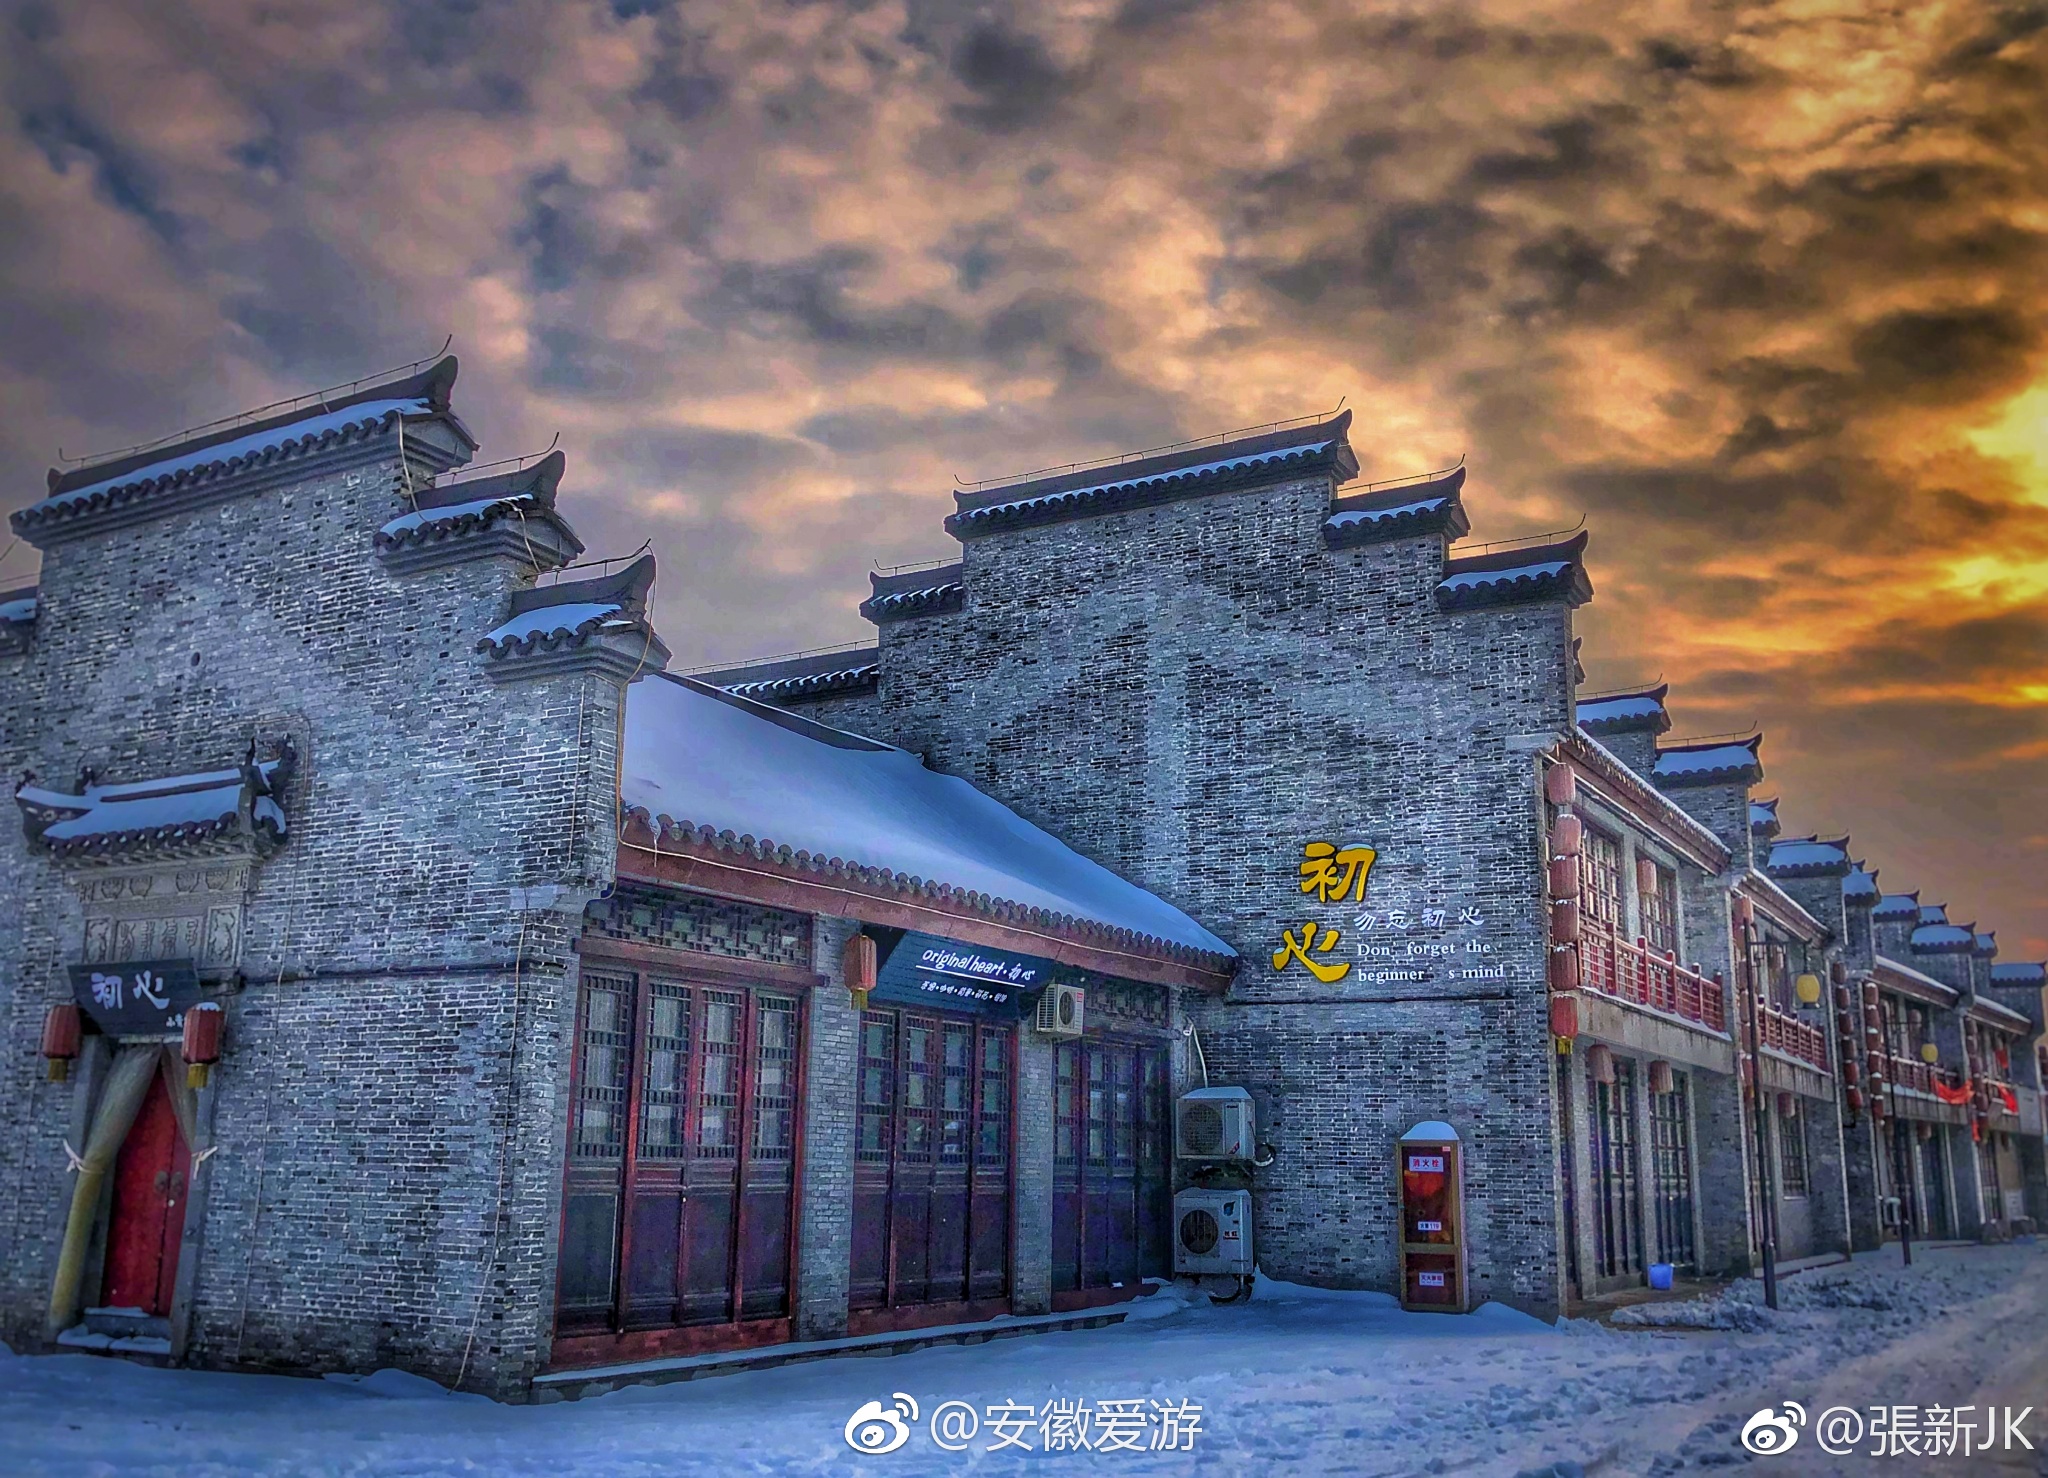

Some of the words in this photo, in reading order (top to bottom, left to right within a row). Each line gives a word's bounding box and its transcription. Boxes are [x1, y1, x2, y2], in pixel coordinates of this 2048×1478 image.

[1272, 842, 1377, 983] 初心
[1353, 906, 1485, 931] 勿忘初心
[1407, 941, 1456, 957] forget
[1465, 939, 1491, 953] the
[922, 949, 975, 970] original
[968, 955, 1006, 976] heart
[1462, 964, 1504, 979] mind
[91, 969, 171, 1010] 初心
[1413, 1158, 1440, 1168] 消火栓
